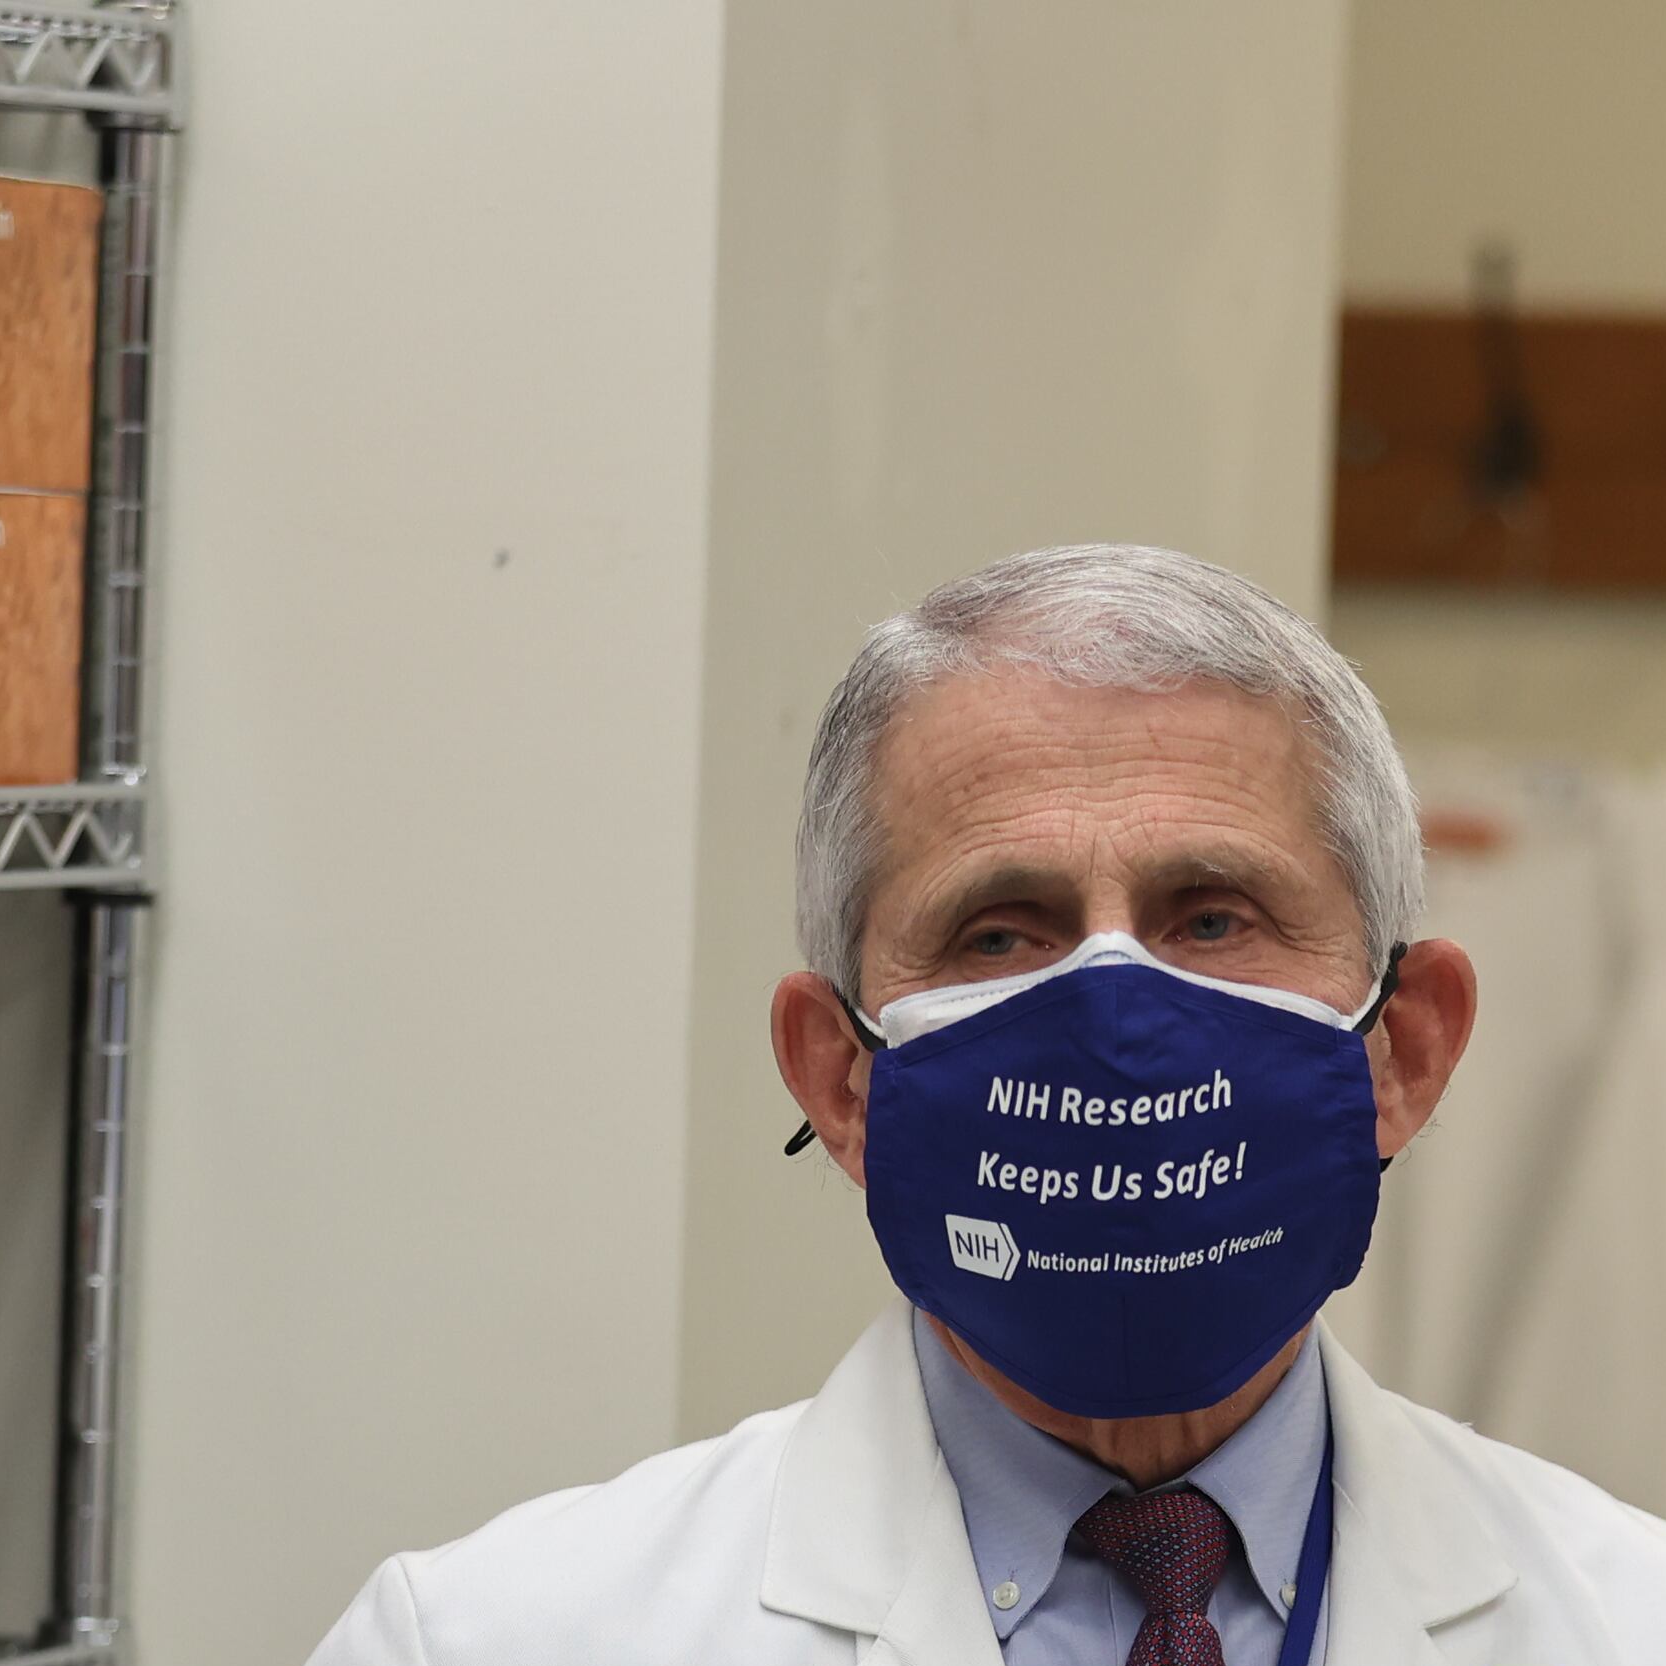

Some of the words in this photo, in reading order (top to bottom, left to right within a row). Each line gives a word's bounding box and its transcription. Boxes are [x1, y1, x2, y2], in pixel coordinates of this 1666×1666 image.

[987, 1076, 1051, 1120] NIH
[1059, 1069, 1232, 1126] Research
[977, 1150, 1080, 1204] Keeps
[1091, 1165, 1143, 1201] Us
[1153, 1141, 1247, 1199] Safe!
[954, 1230, 1000, 1263] NIH
[1027, 1249, 1109, 1272] National
[1114, 1240, 1205, 1274] Institutes
[1208, 1239, 1227, 1264] of
[1228, 1226, 1284, 1256] Health
